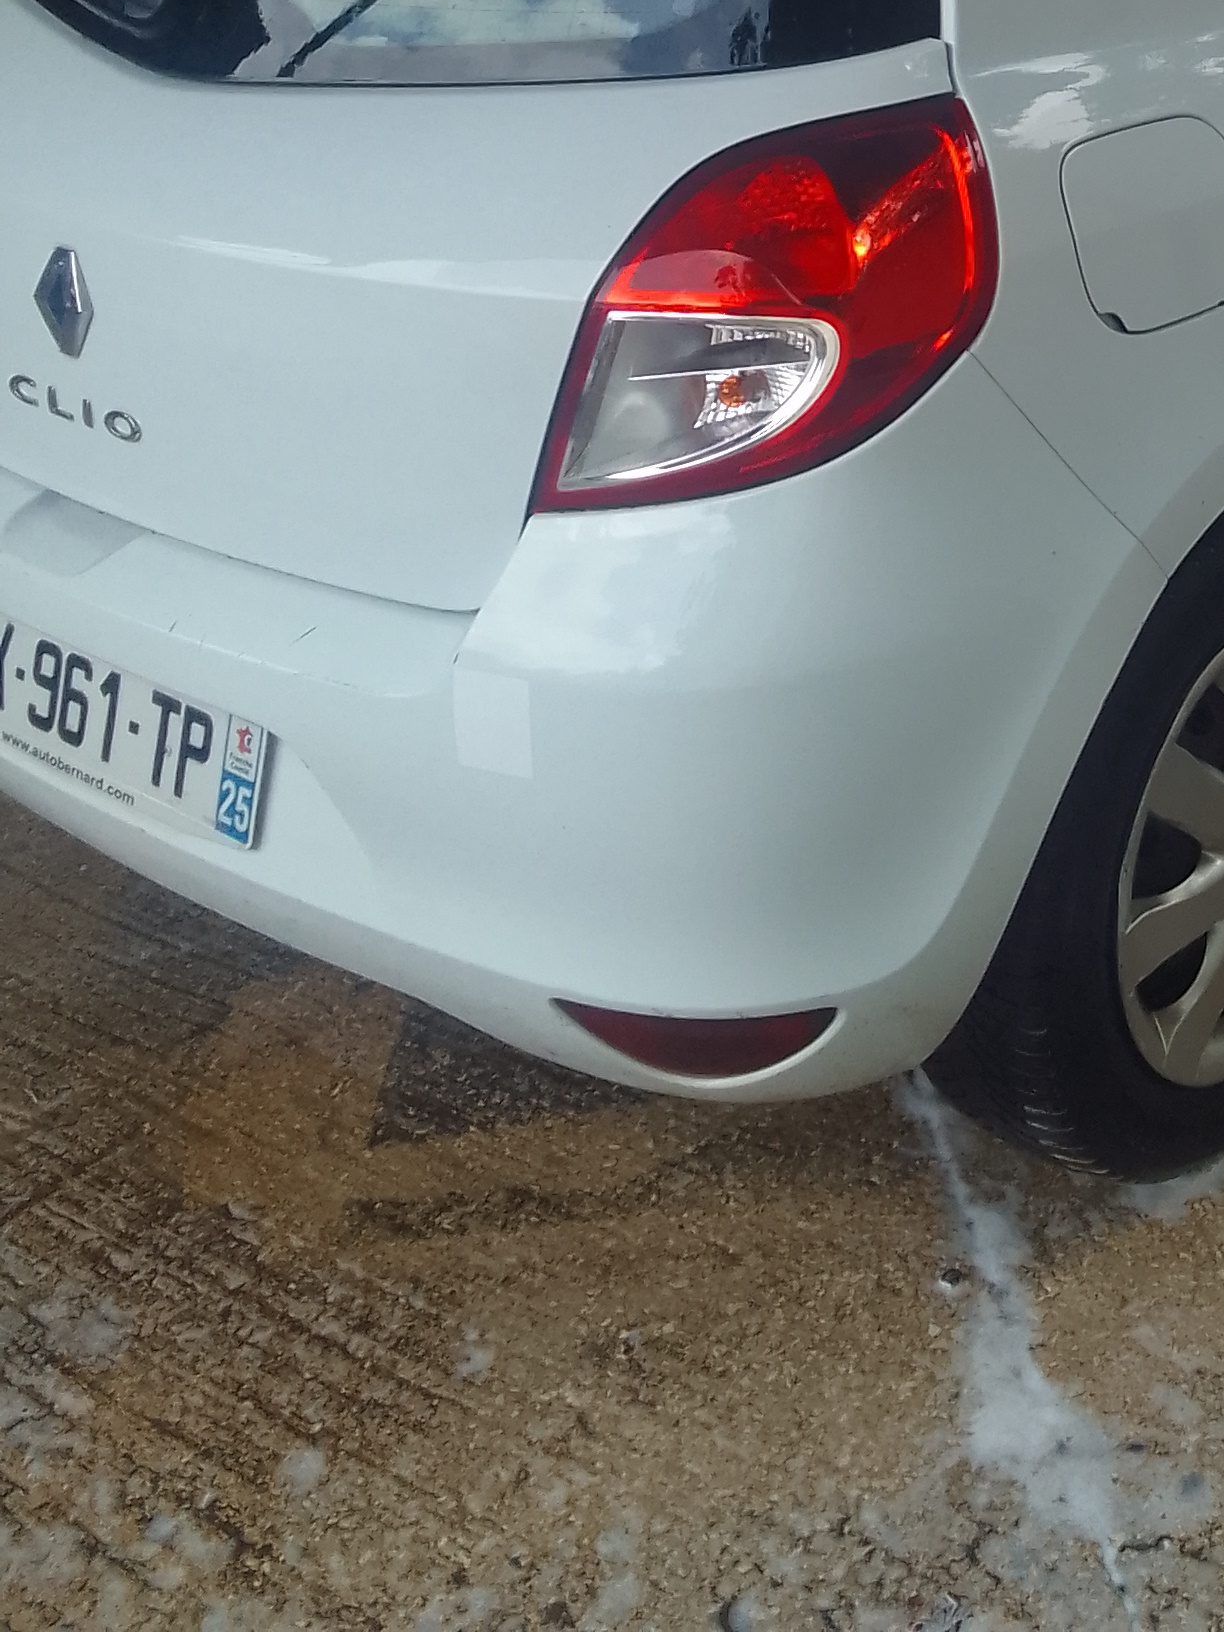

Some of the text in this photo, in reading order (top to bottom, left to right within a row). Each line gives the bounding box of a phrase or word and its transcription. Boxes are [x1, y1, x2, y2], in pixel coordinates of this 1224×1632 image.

[8, 373, 143, 444] CLIO
[2, 729, 136, 807] www.autobernard.com
[217, 778, 253, 833] 25
